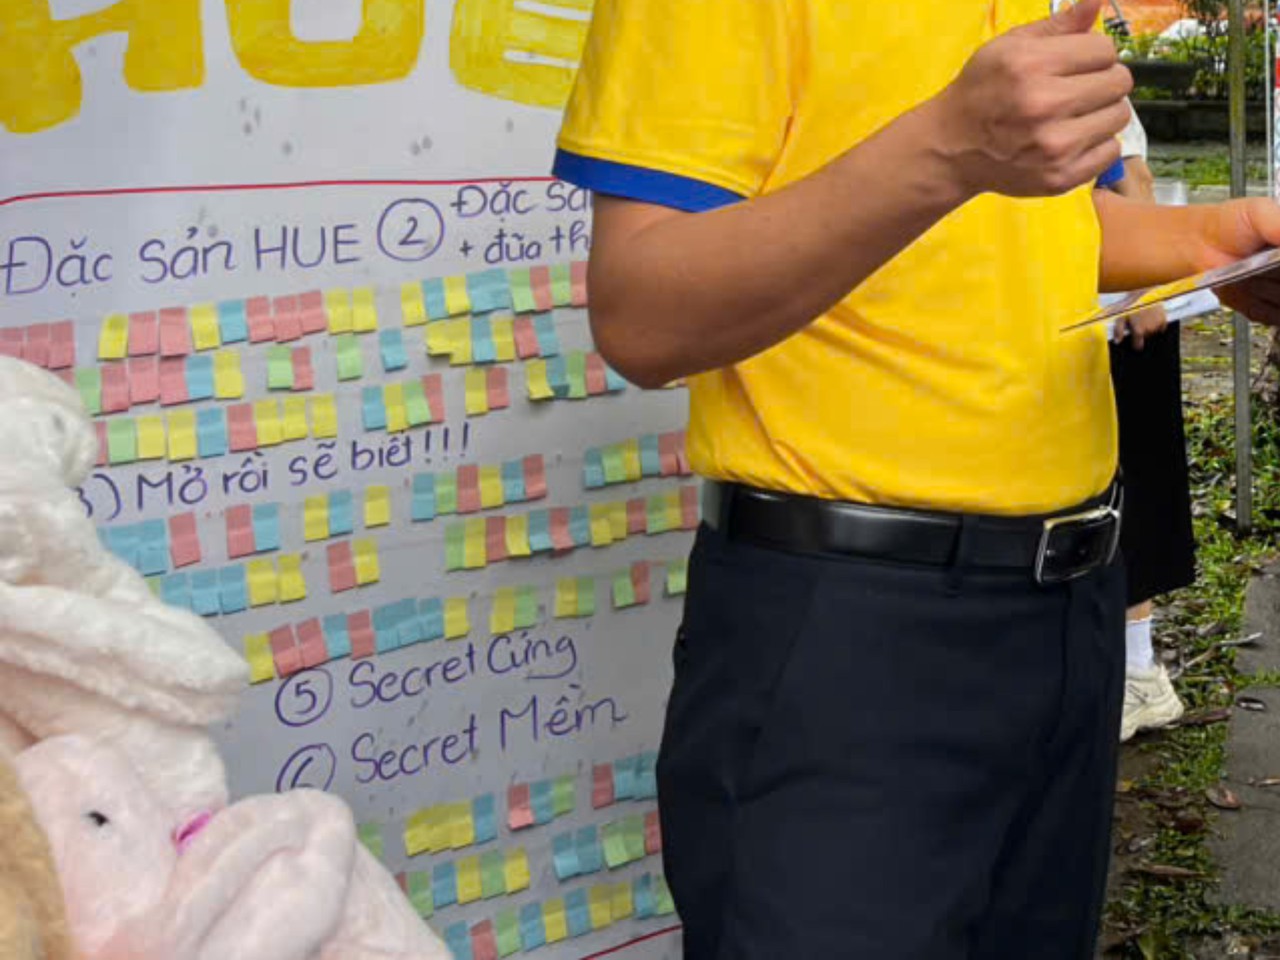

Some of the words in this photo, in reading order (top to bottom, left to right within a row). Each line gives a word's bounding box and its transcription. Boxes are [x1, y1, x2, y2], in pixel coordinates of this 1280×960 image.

[451, 180, 539, 223] Đặc
[0, 235, 113, 297] Đặc
[139, 226, 238, 284] Sản
[255, 224, 361, 271] HUE
[484, 228, 541, 264] đũa
[137, 464, 208, 510] Mở
[222, 452, 269, 493] rồi
[289, 442, 338, 486] sẽ
[348, 648, 475, 708] Secret
[351, 714, 478, 783] Secret
